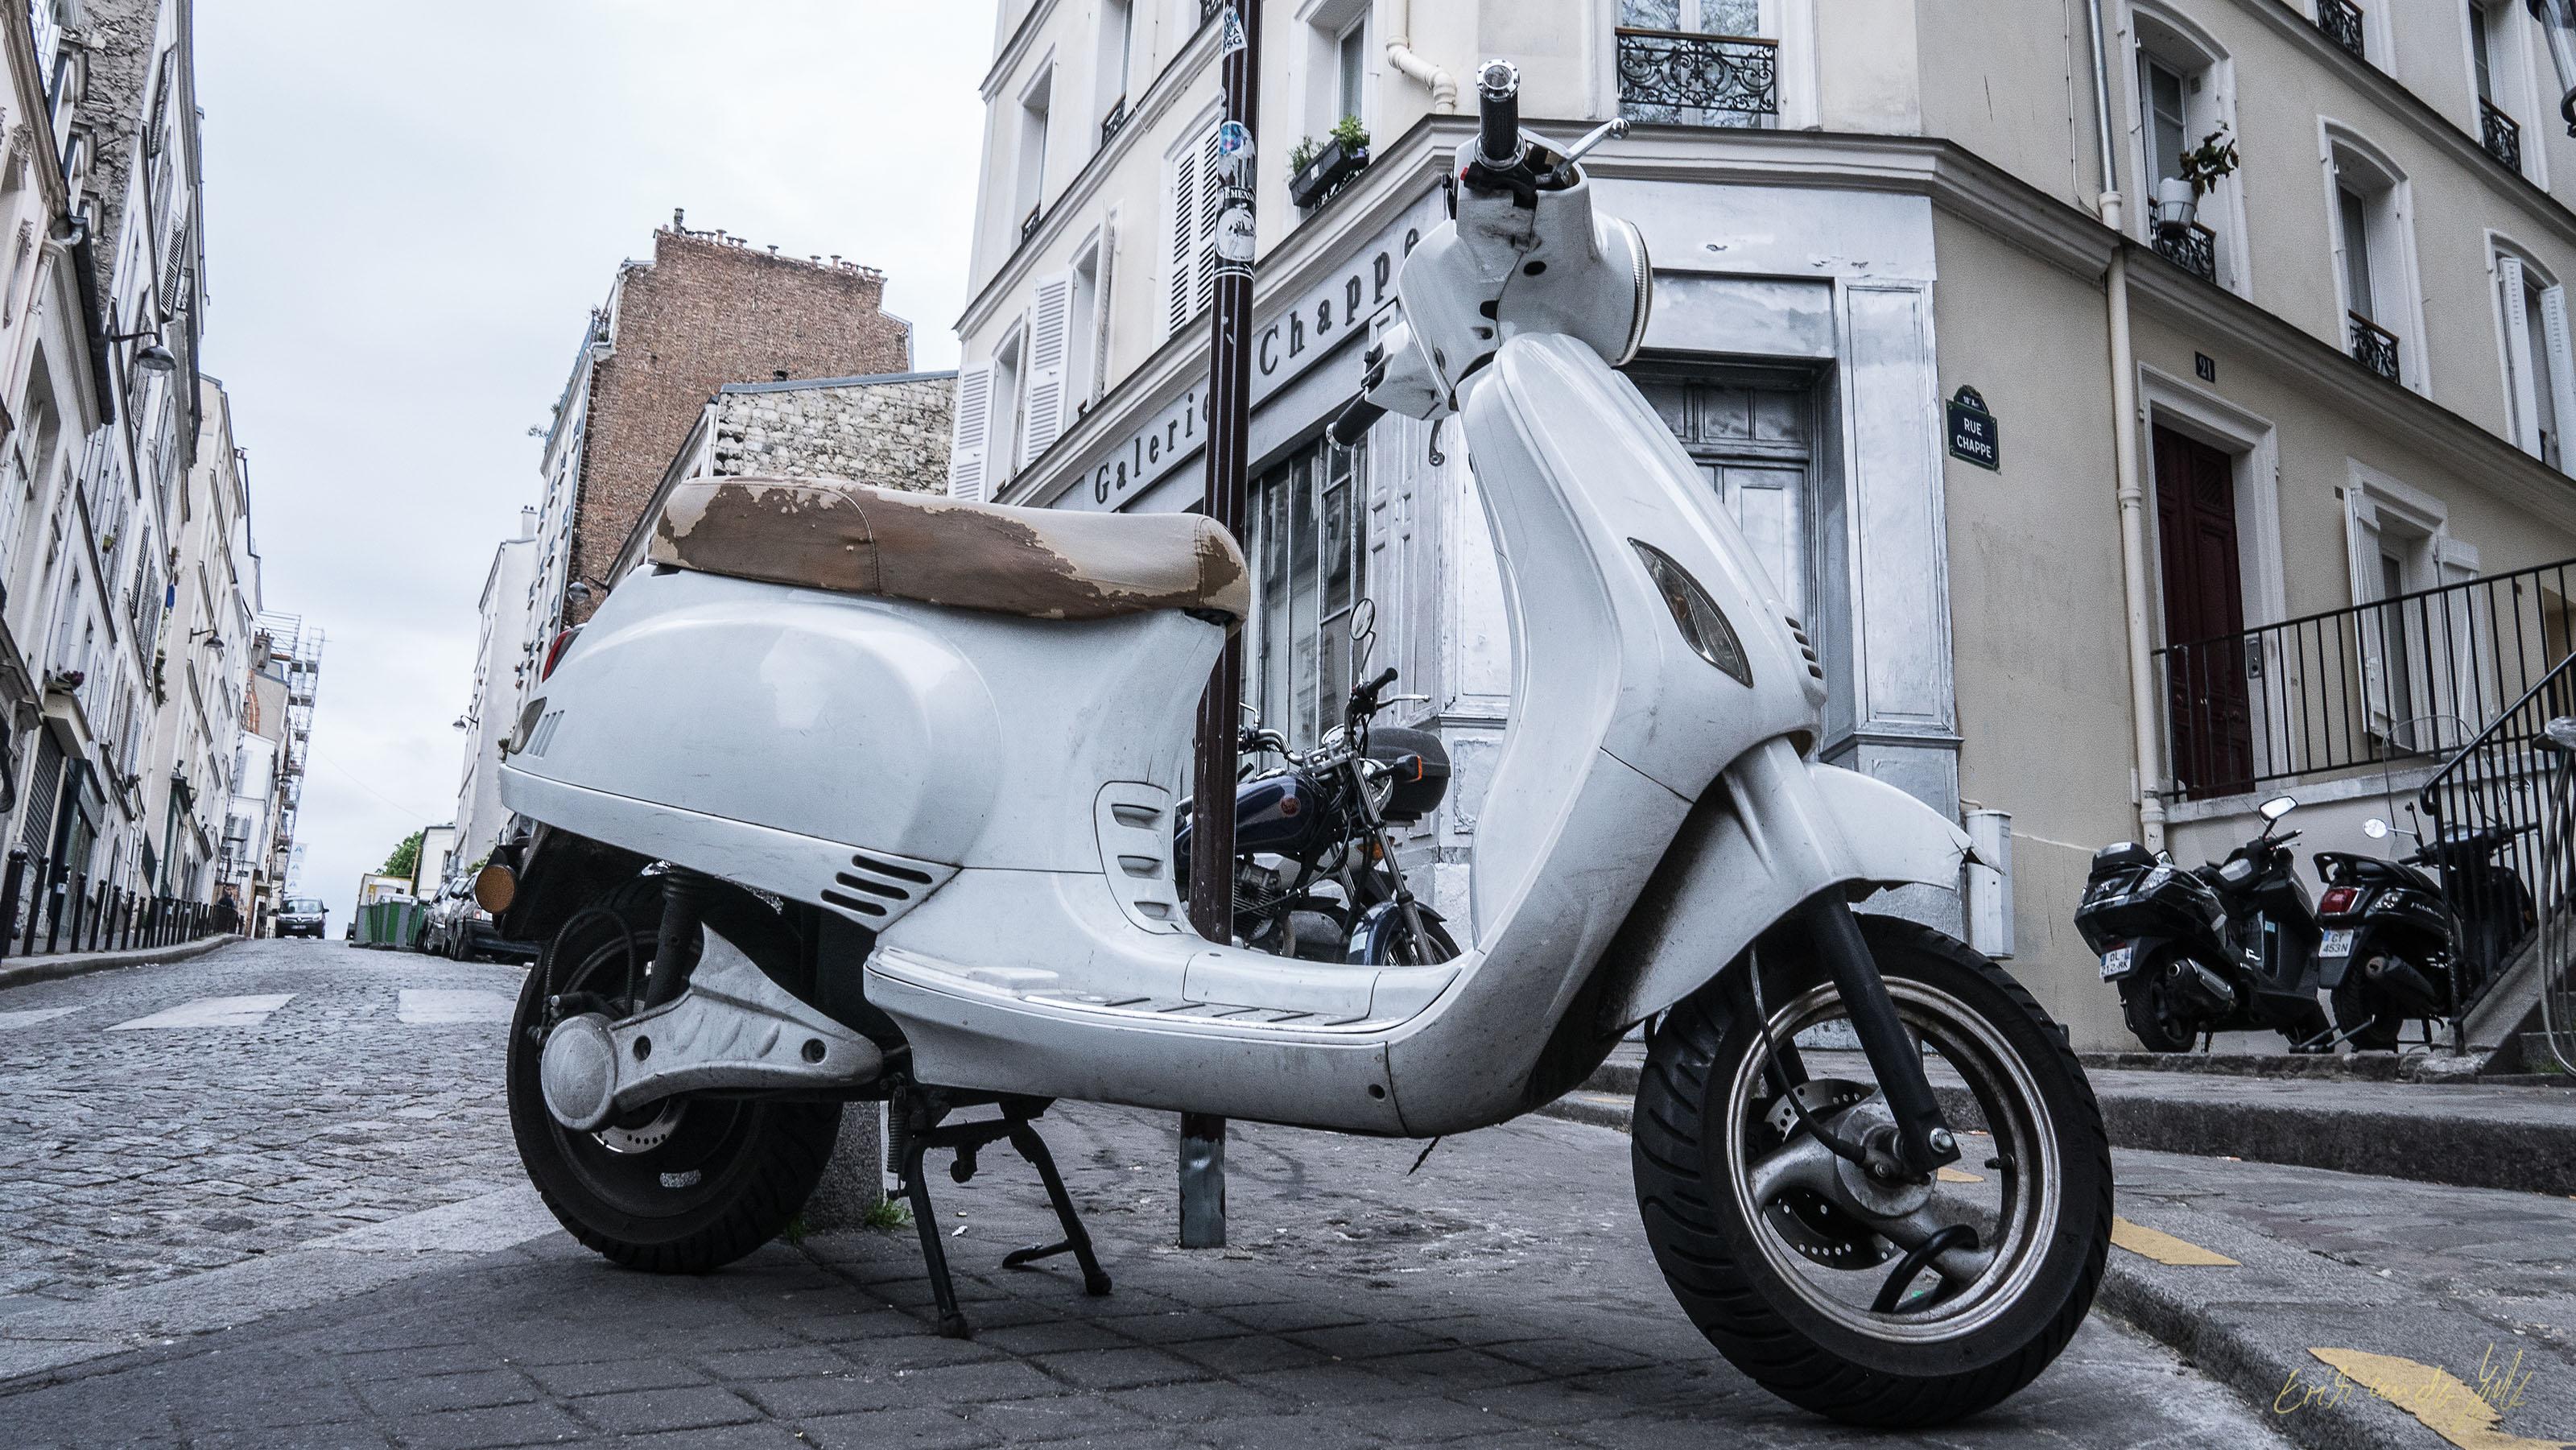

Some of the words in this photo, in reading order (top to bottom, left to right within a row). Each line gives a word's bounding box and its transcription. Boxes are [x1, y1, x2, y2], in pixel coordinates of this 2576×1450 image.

[1259, 228, 1420, 376] Chappe
[2198, 357, 2212, 381] 21
[1964, 417, 1982, 436] RUE
[1956, 434, 1992, 459] CHAPPE
